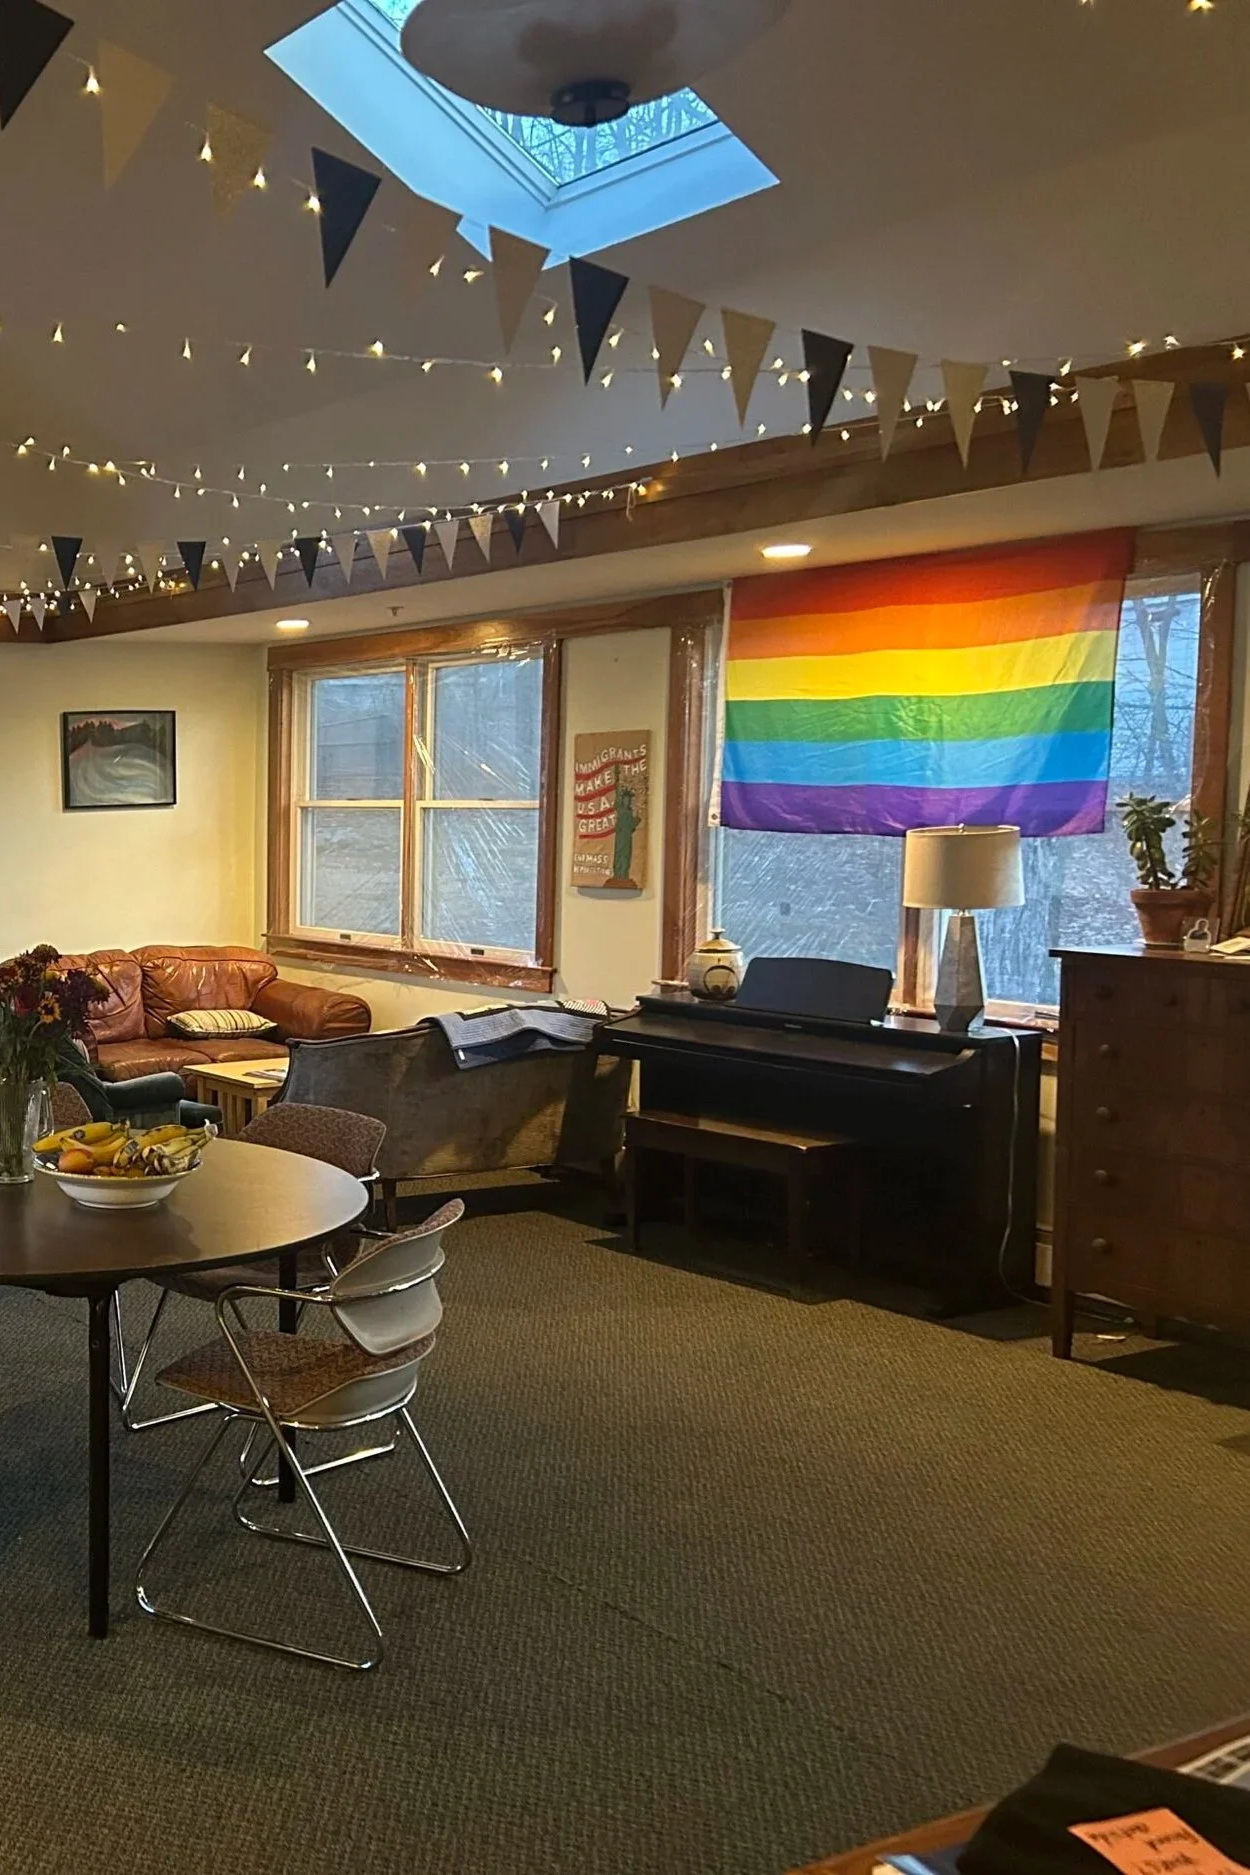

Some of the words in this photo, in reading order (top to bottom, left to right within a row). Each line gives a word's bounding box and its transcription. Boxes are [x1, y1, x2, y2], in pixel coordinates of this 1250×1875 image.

[575, 744, 647, 774] IMMIGRANTS
[575, 770, 612, 796] MAKE
[623, 759, 647, 776] THE
[578, 814, 616, 833] GREAT
